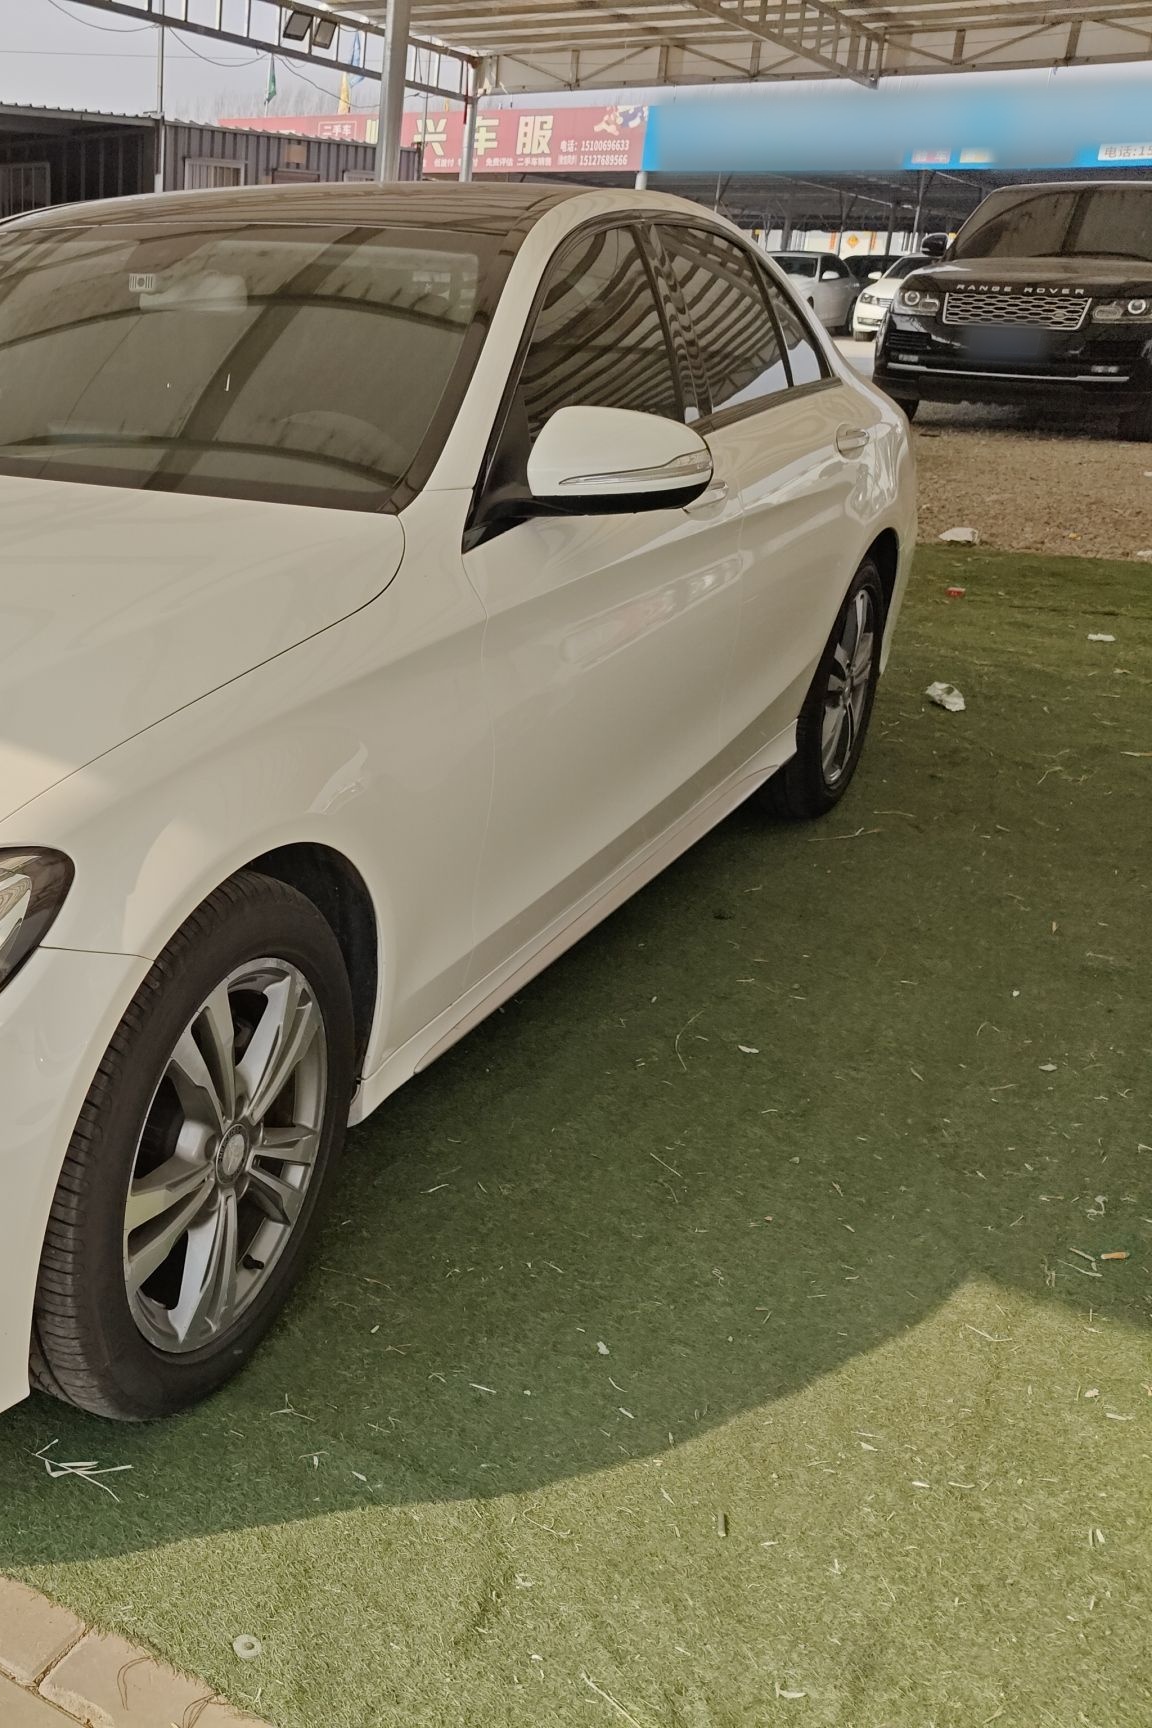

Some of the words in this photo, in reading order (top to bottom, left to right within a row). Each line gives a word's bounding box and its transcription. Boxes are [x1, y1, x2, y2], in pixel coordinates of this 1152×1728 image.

[323, 124, 351, 136] 二手车
[581, 139, 630, 151] 15100696633
[579, 154, 628, 166] 15127689566
[956, 284, 1012, 292] RANGE
[1023, 287, 1084, 295] ROVER
